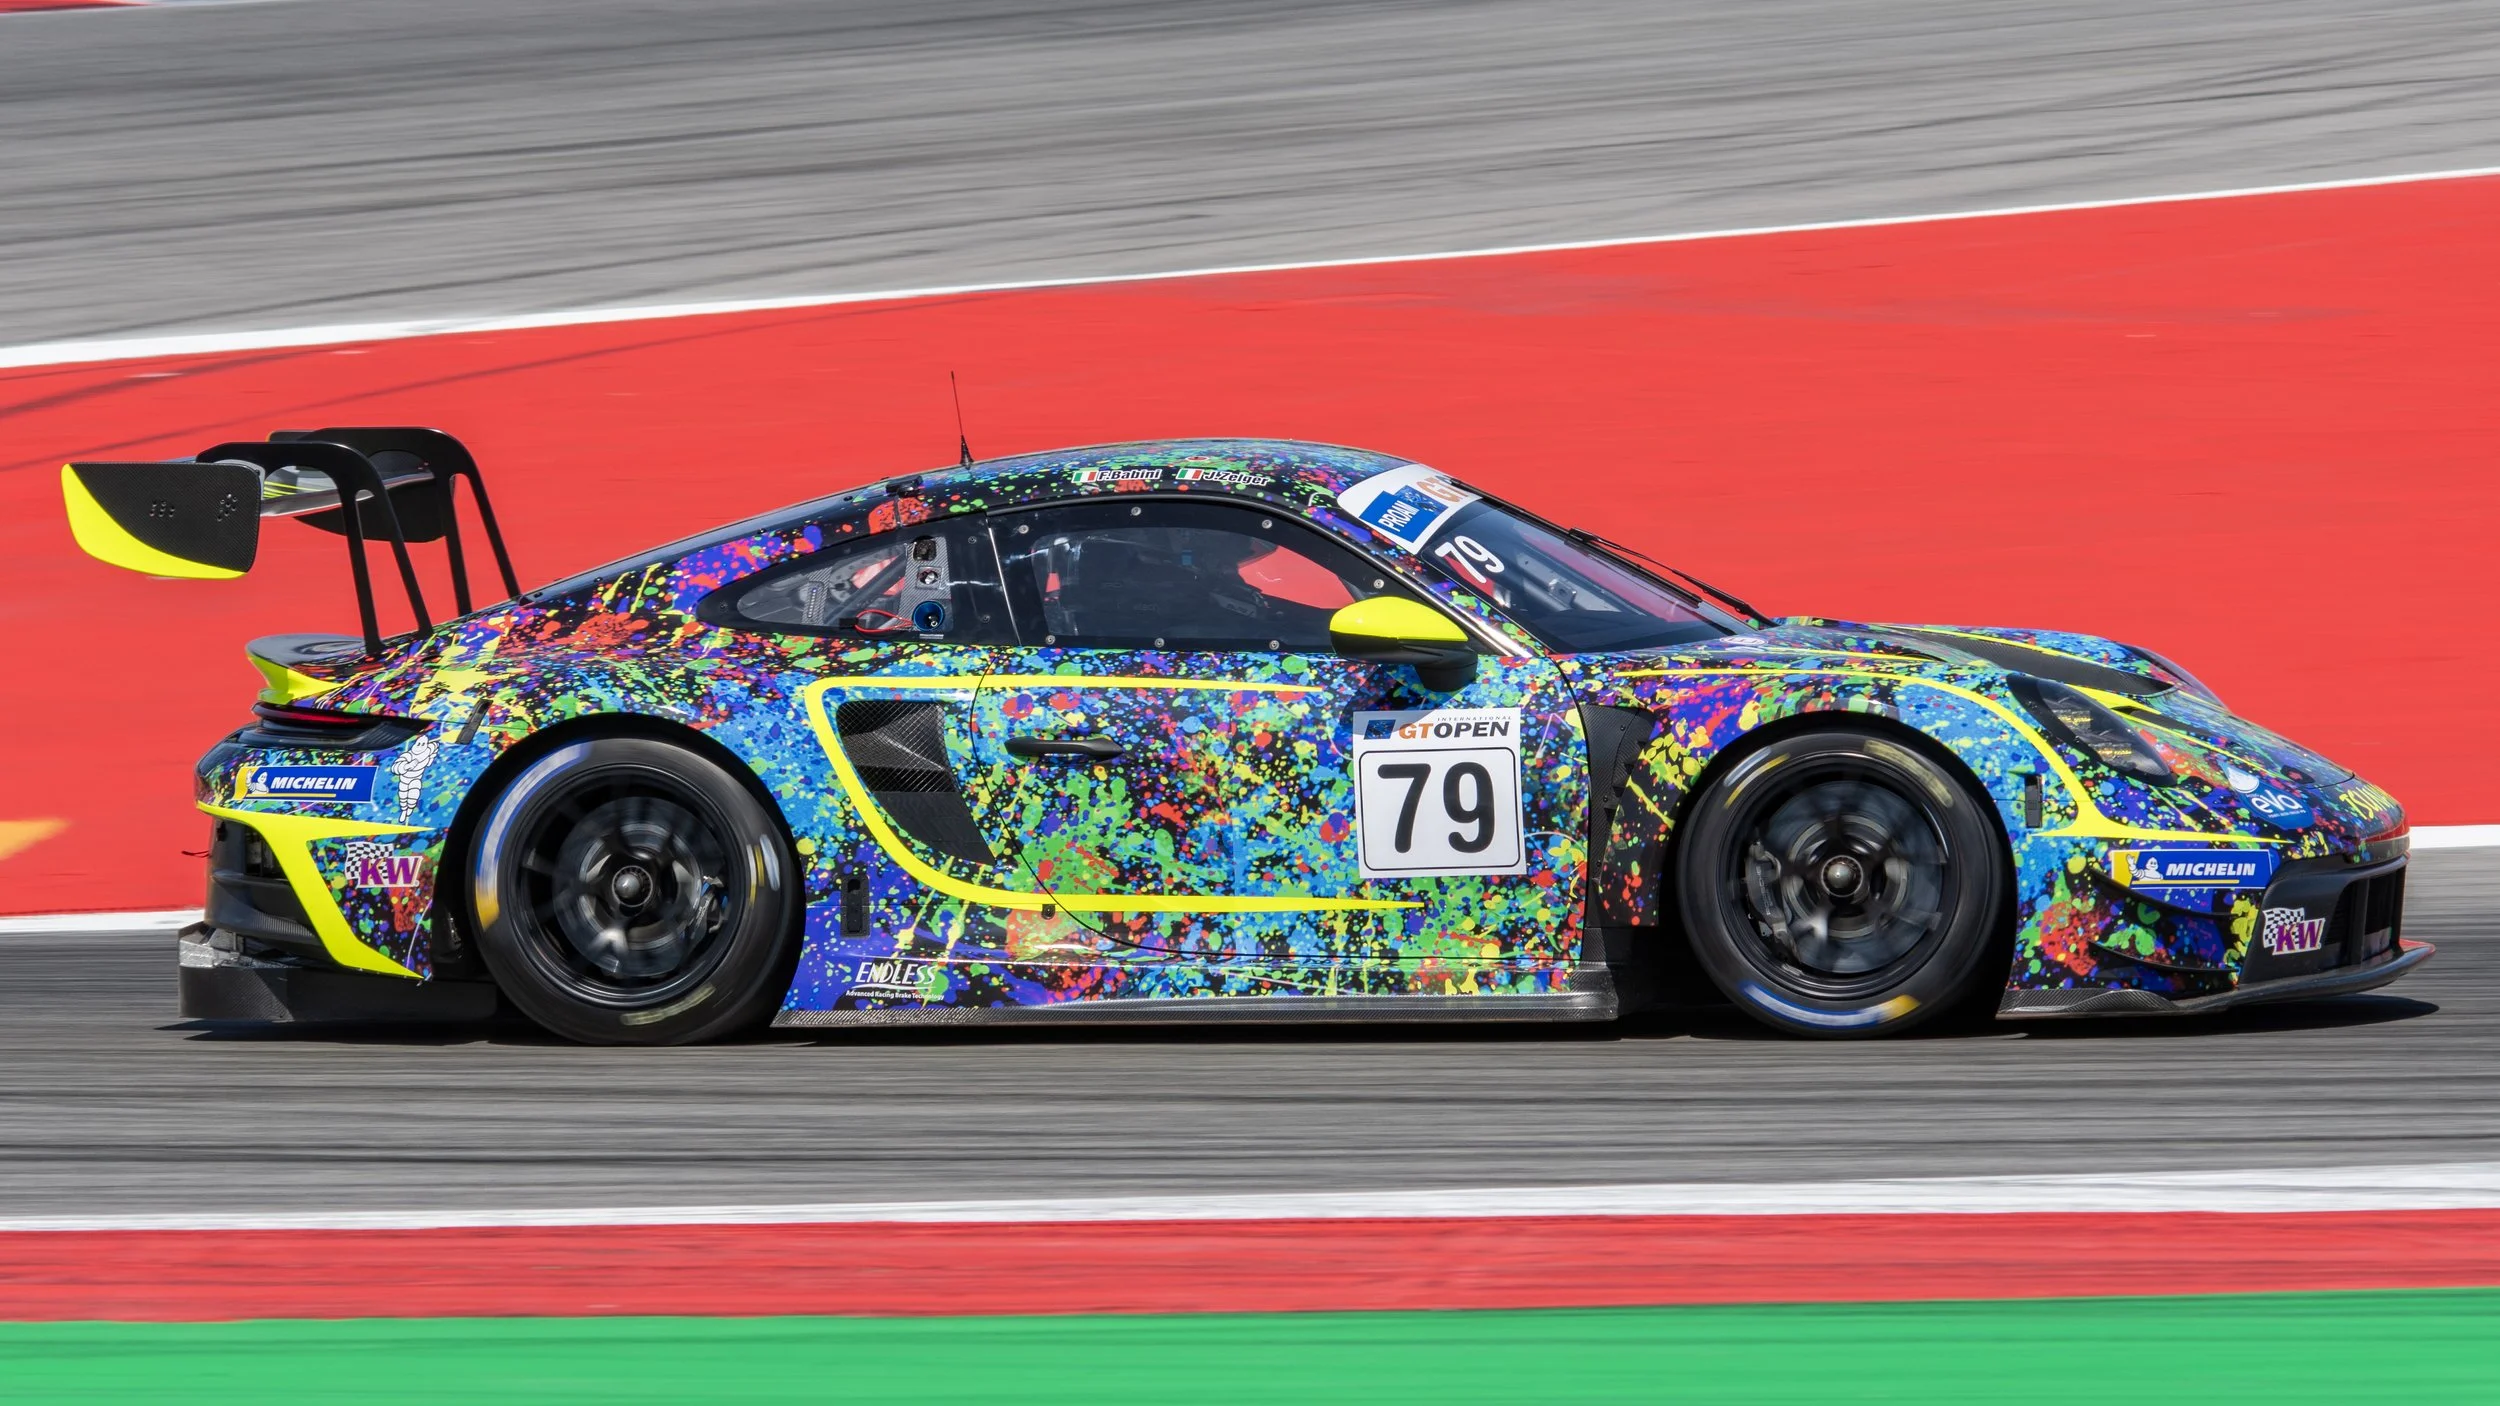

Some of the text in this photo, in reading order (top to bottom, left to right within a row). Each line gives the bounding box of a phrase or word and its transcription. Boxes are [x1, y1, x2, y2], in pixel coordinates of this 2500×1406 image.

[1377, 500, 1421, 533] PROAM
[1434, 535, 1505, 584] 79
[270, 776, 358, 791] MICHELIN
[1377, 761, 1496, 854] 79
[2251, 789, 2304, 814] eva
[358, 857, 420, 887] KW
[2165, 862, 2257, 877] MICHELIN
[2274, 920, 2323, 954] KW
[854, 961, 938, 985] ENDLESS
[845, 989, 874, 998] Advanced
[875, 990, 894, 1000] Racing
[894, 991, 912, 999] Brake
